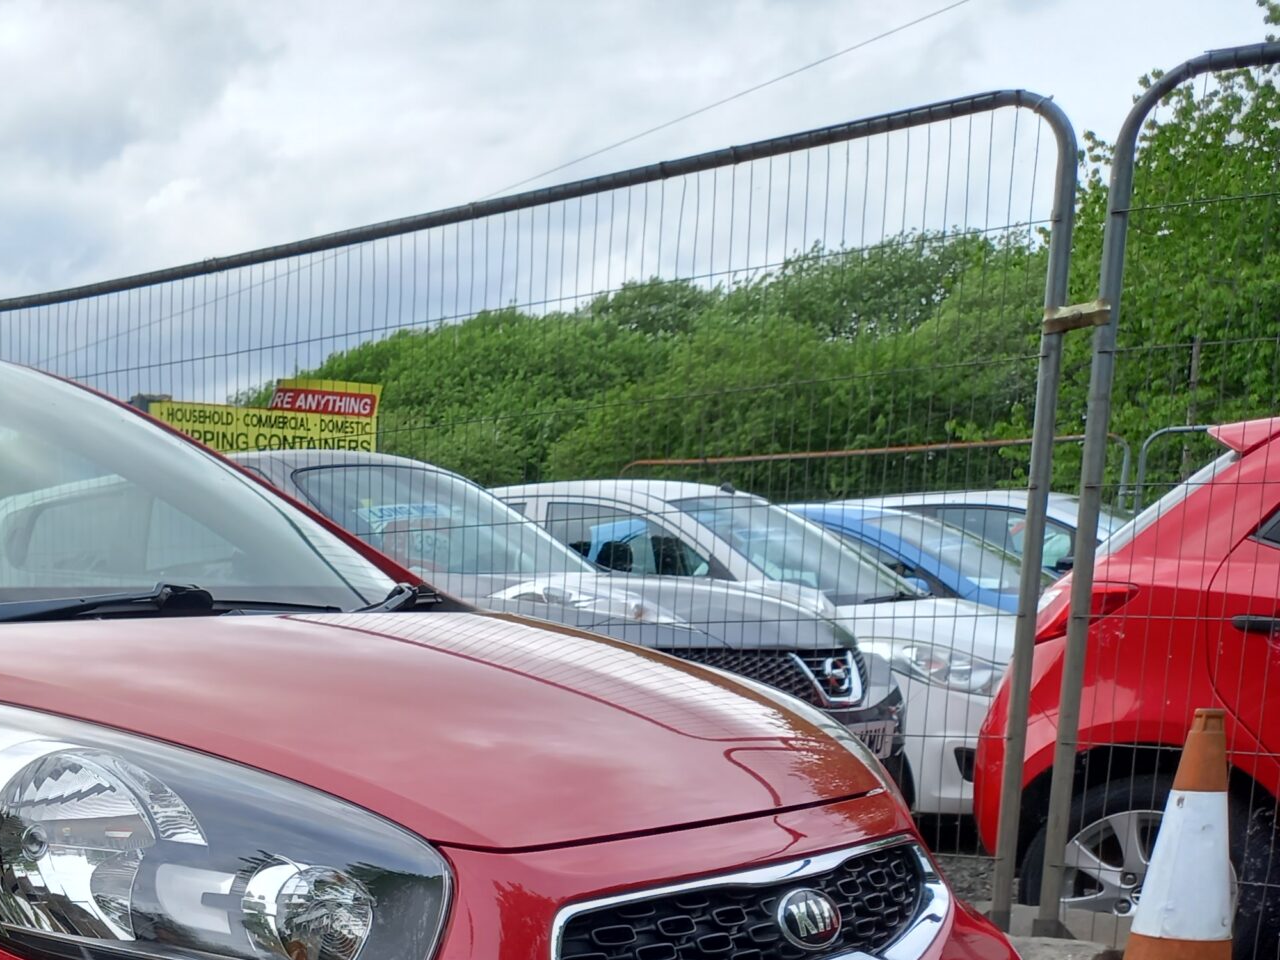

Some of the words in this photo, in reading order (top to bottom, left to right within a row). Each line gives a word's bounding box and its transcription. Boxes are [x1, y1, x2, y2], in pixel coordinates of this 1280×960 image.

[295, 393, 371, 414] ANYTHING
[167, 407, 234, 426] HOUSEHOLD
[243, 413, 311, 431] COMMERCIAL
[320, 418, 371, 434] DOMESTIC
[180, 428, 249, 451] PPING
[255, 433, 371, 453] CONTAINERS
[788, 897, 838, 937] KIA
